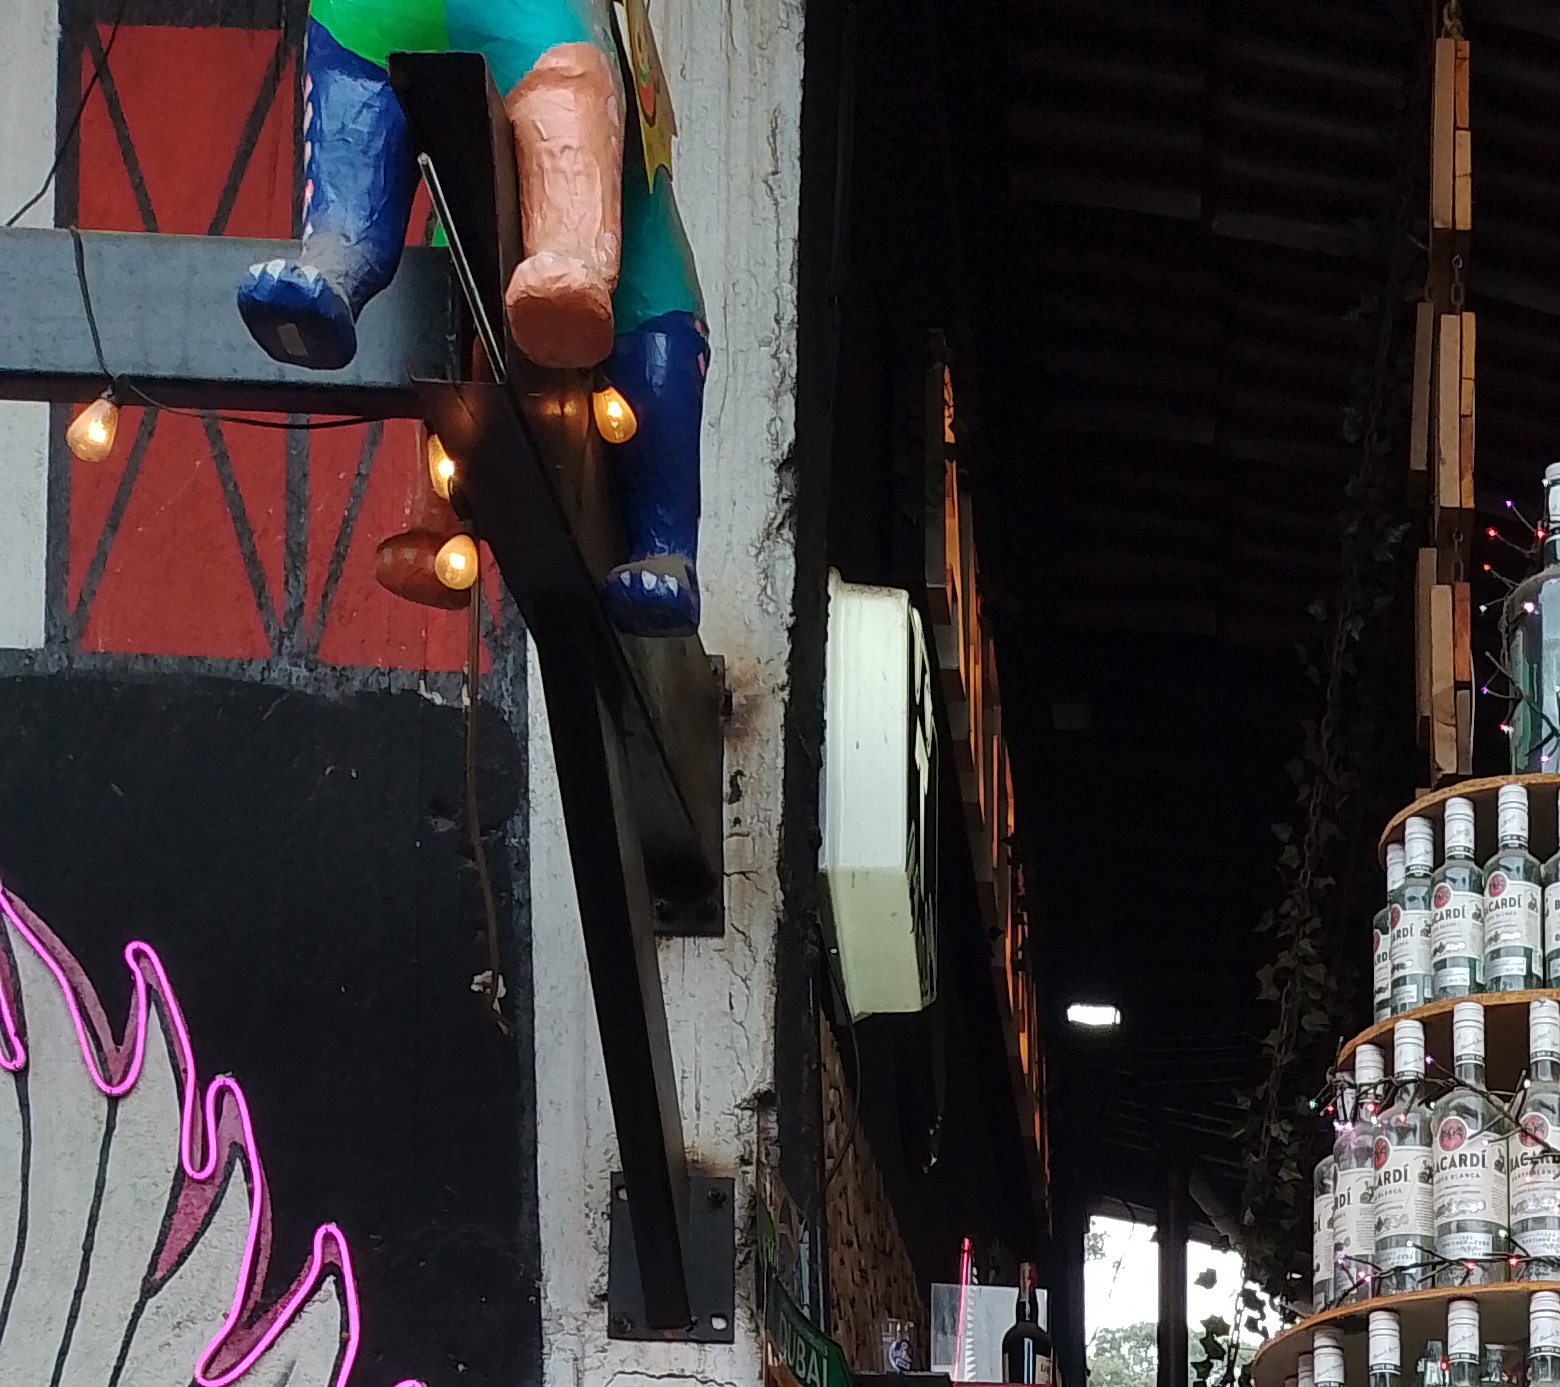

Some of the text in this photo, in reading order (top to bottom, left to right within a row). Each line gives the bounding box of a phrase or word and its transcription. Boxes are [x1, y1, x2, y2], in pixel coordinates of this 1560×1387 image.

[1487, 894, 1522, 912] CARDÍ
[1433, 905, 1467, 923] CARDÍ
[1390, 923, 1414, 942] ARDÍ
[1435, 1149, 1488, 1173] ACARDÍ
[1377, 1163, 1410, 1187] ARDÍ
